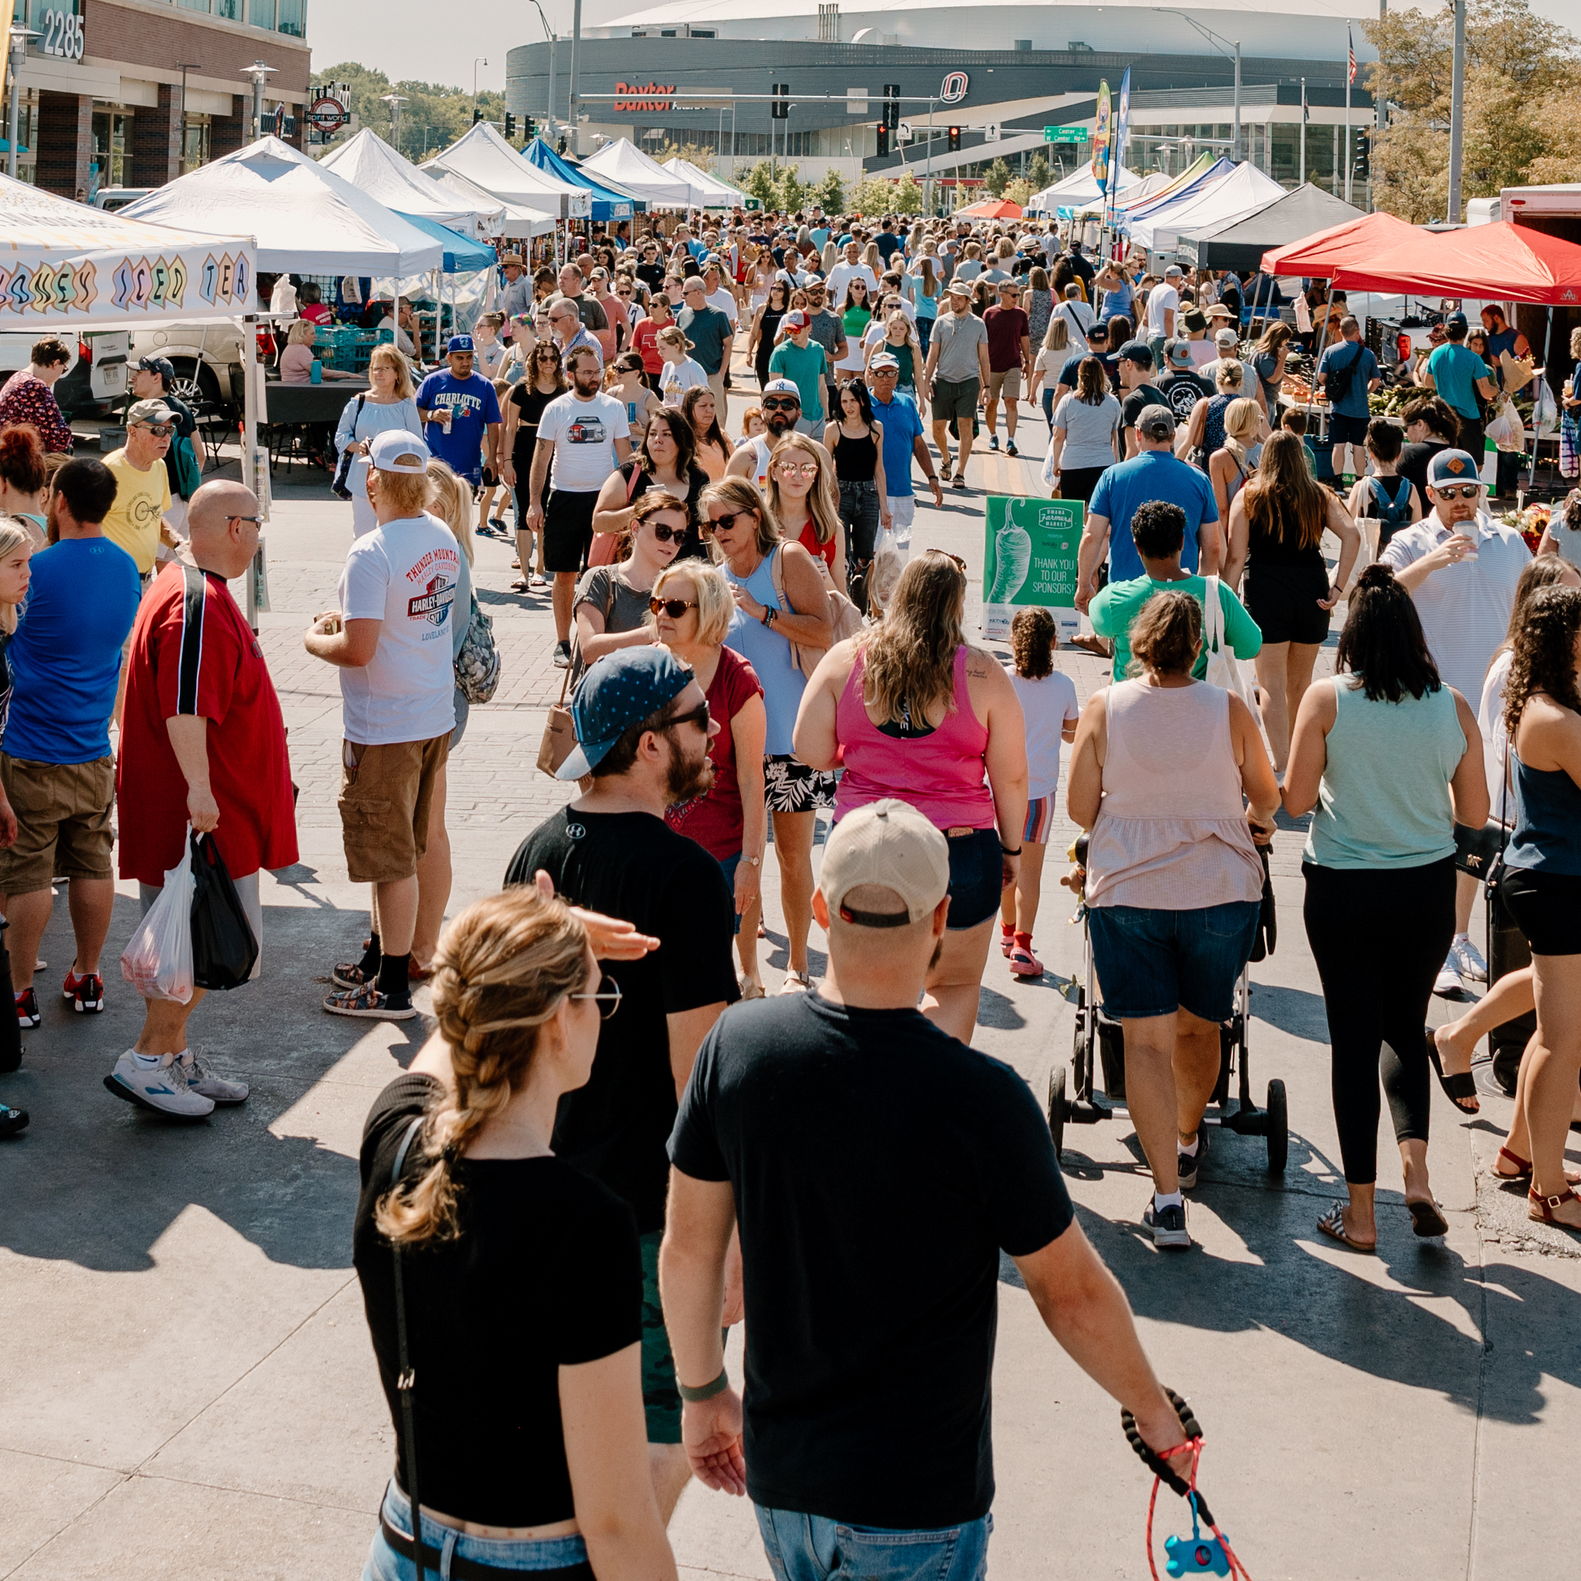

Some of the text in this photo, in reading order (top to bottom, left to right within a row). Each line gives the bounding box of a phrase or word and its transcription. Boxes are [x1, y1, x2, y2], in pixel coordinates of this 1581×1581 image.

[43, 7, 85, 61] 2285
[326, 113, 348, 122] world
[119, 266, 183, 303] ICED
[206, 262, 245, 297] TEA
[434, 393, 482, 411] CHARLOTTE
[1040, 513, 1072, 524] Farmers
[405, 551, 434, 583] THUNDER
[1033, 557, 1075, 570] THANK YOU
[1041, 570, 1067, 582] TO OUR
[1032, 582, 1075, 595] SPONSORS!
